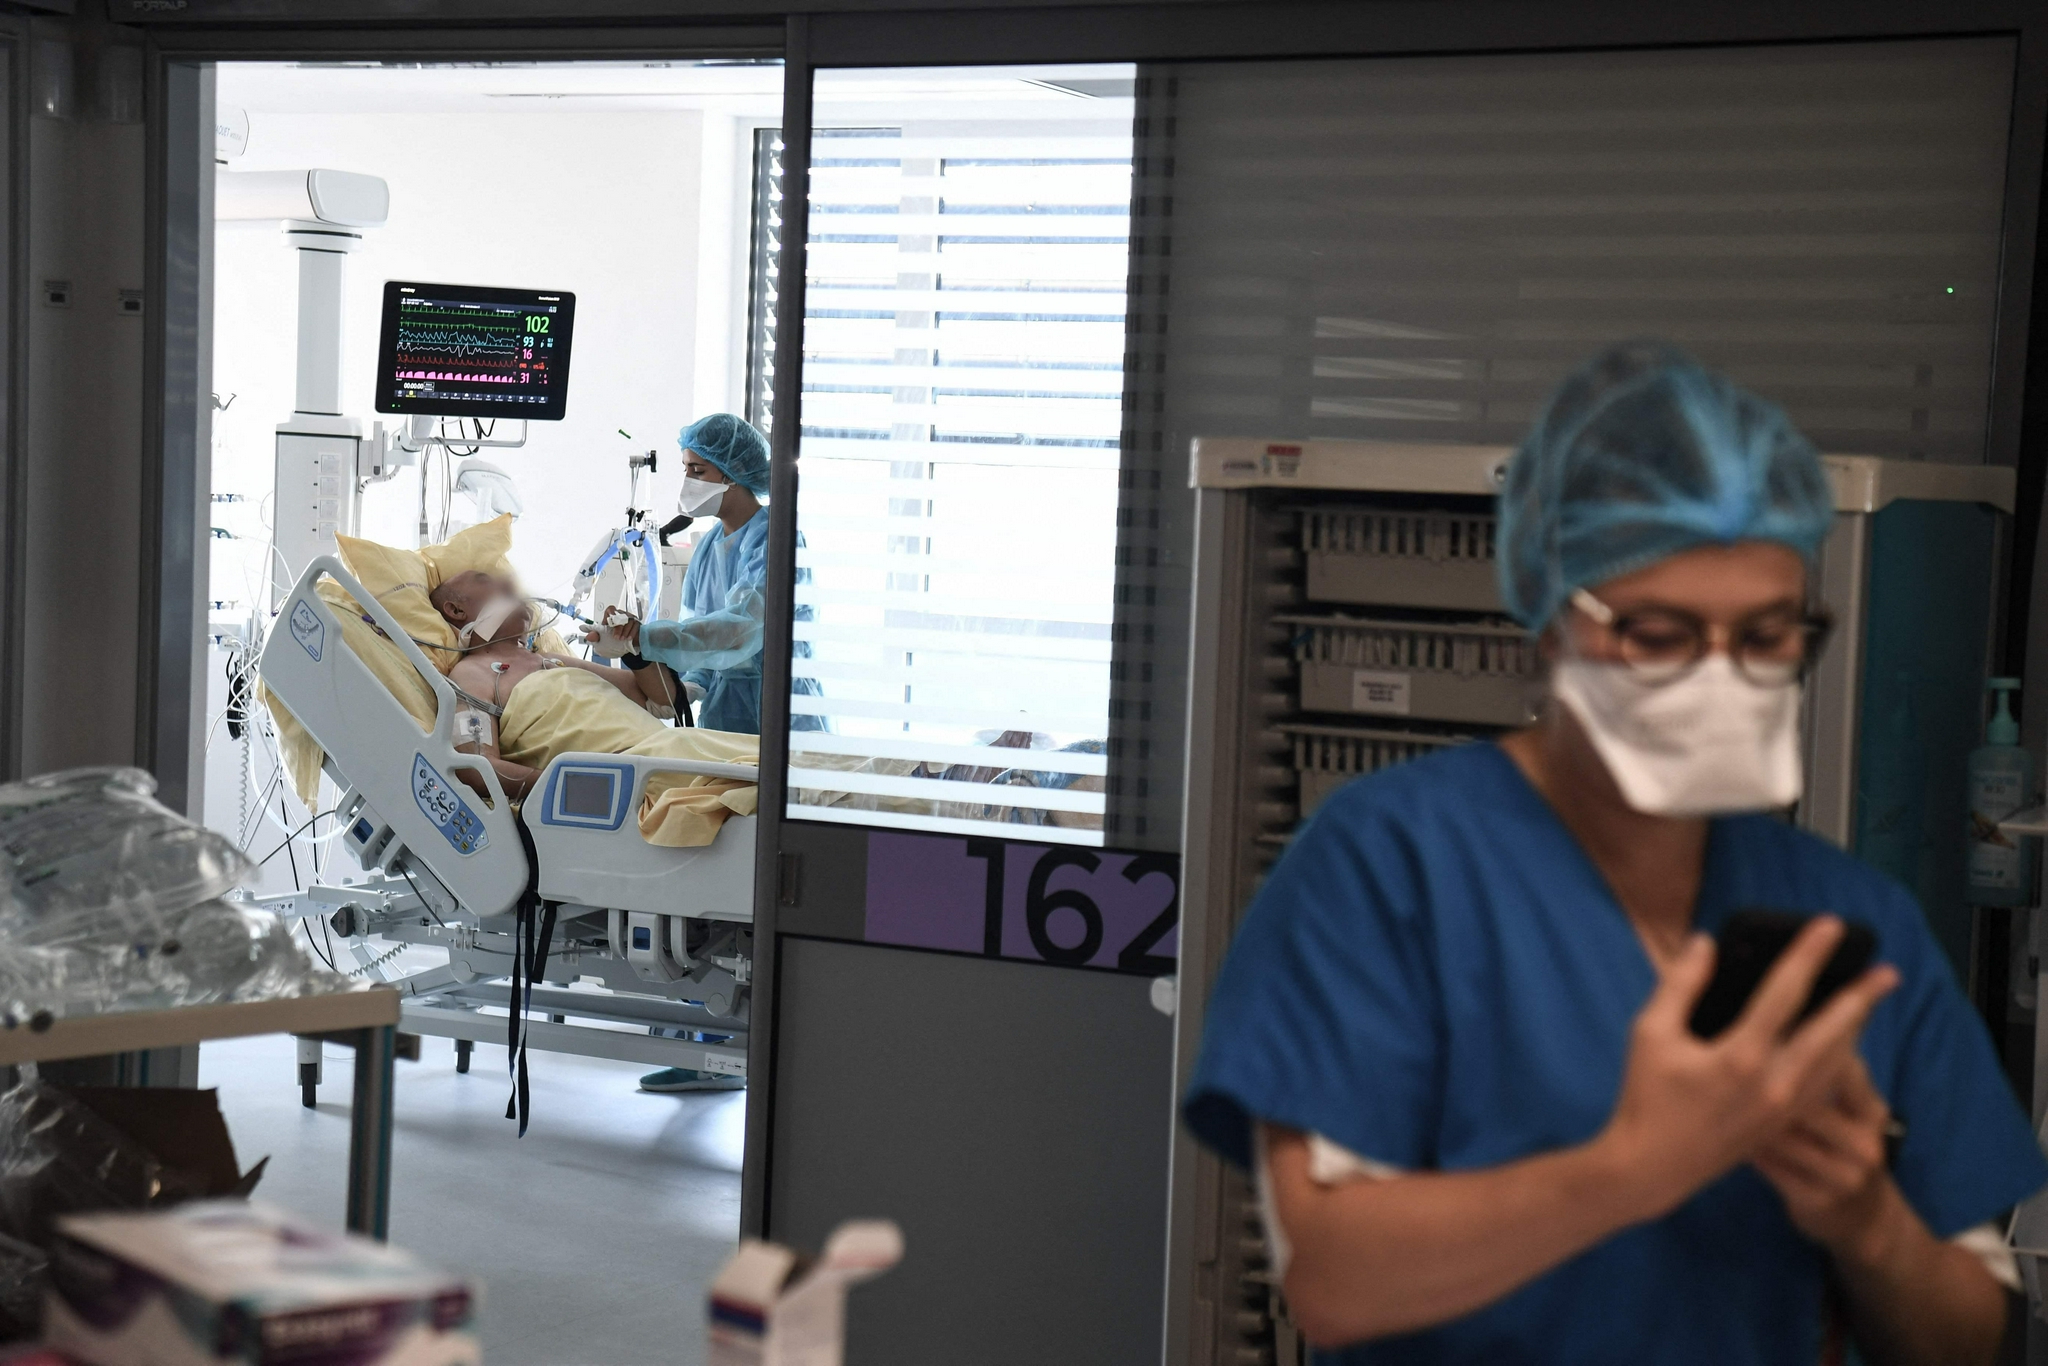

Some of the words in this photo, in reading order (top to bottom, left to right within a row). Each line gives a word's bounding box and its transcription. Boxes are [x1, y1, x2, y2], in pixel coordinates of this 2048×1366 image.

[133, 0, 187, 11] PORTALP
[525, 315, 550, 333] 102
[523, 336, 534, 347] 93
[522, 348, 533, 360] 16
[519, 372, 530, 384] 31
[967, 839, 1180, 972] 162
